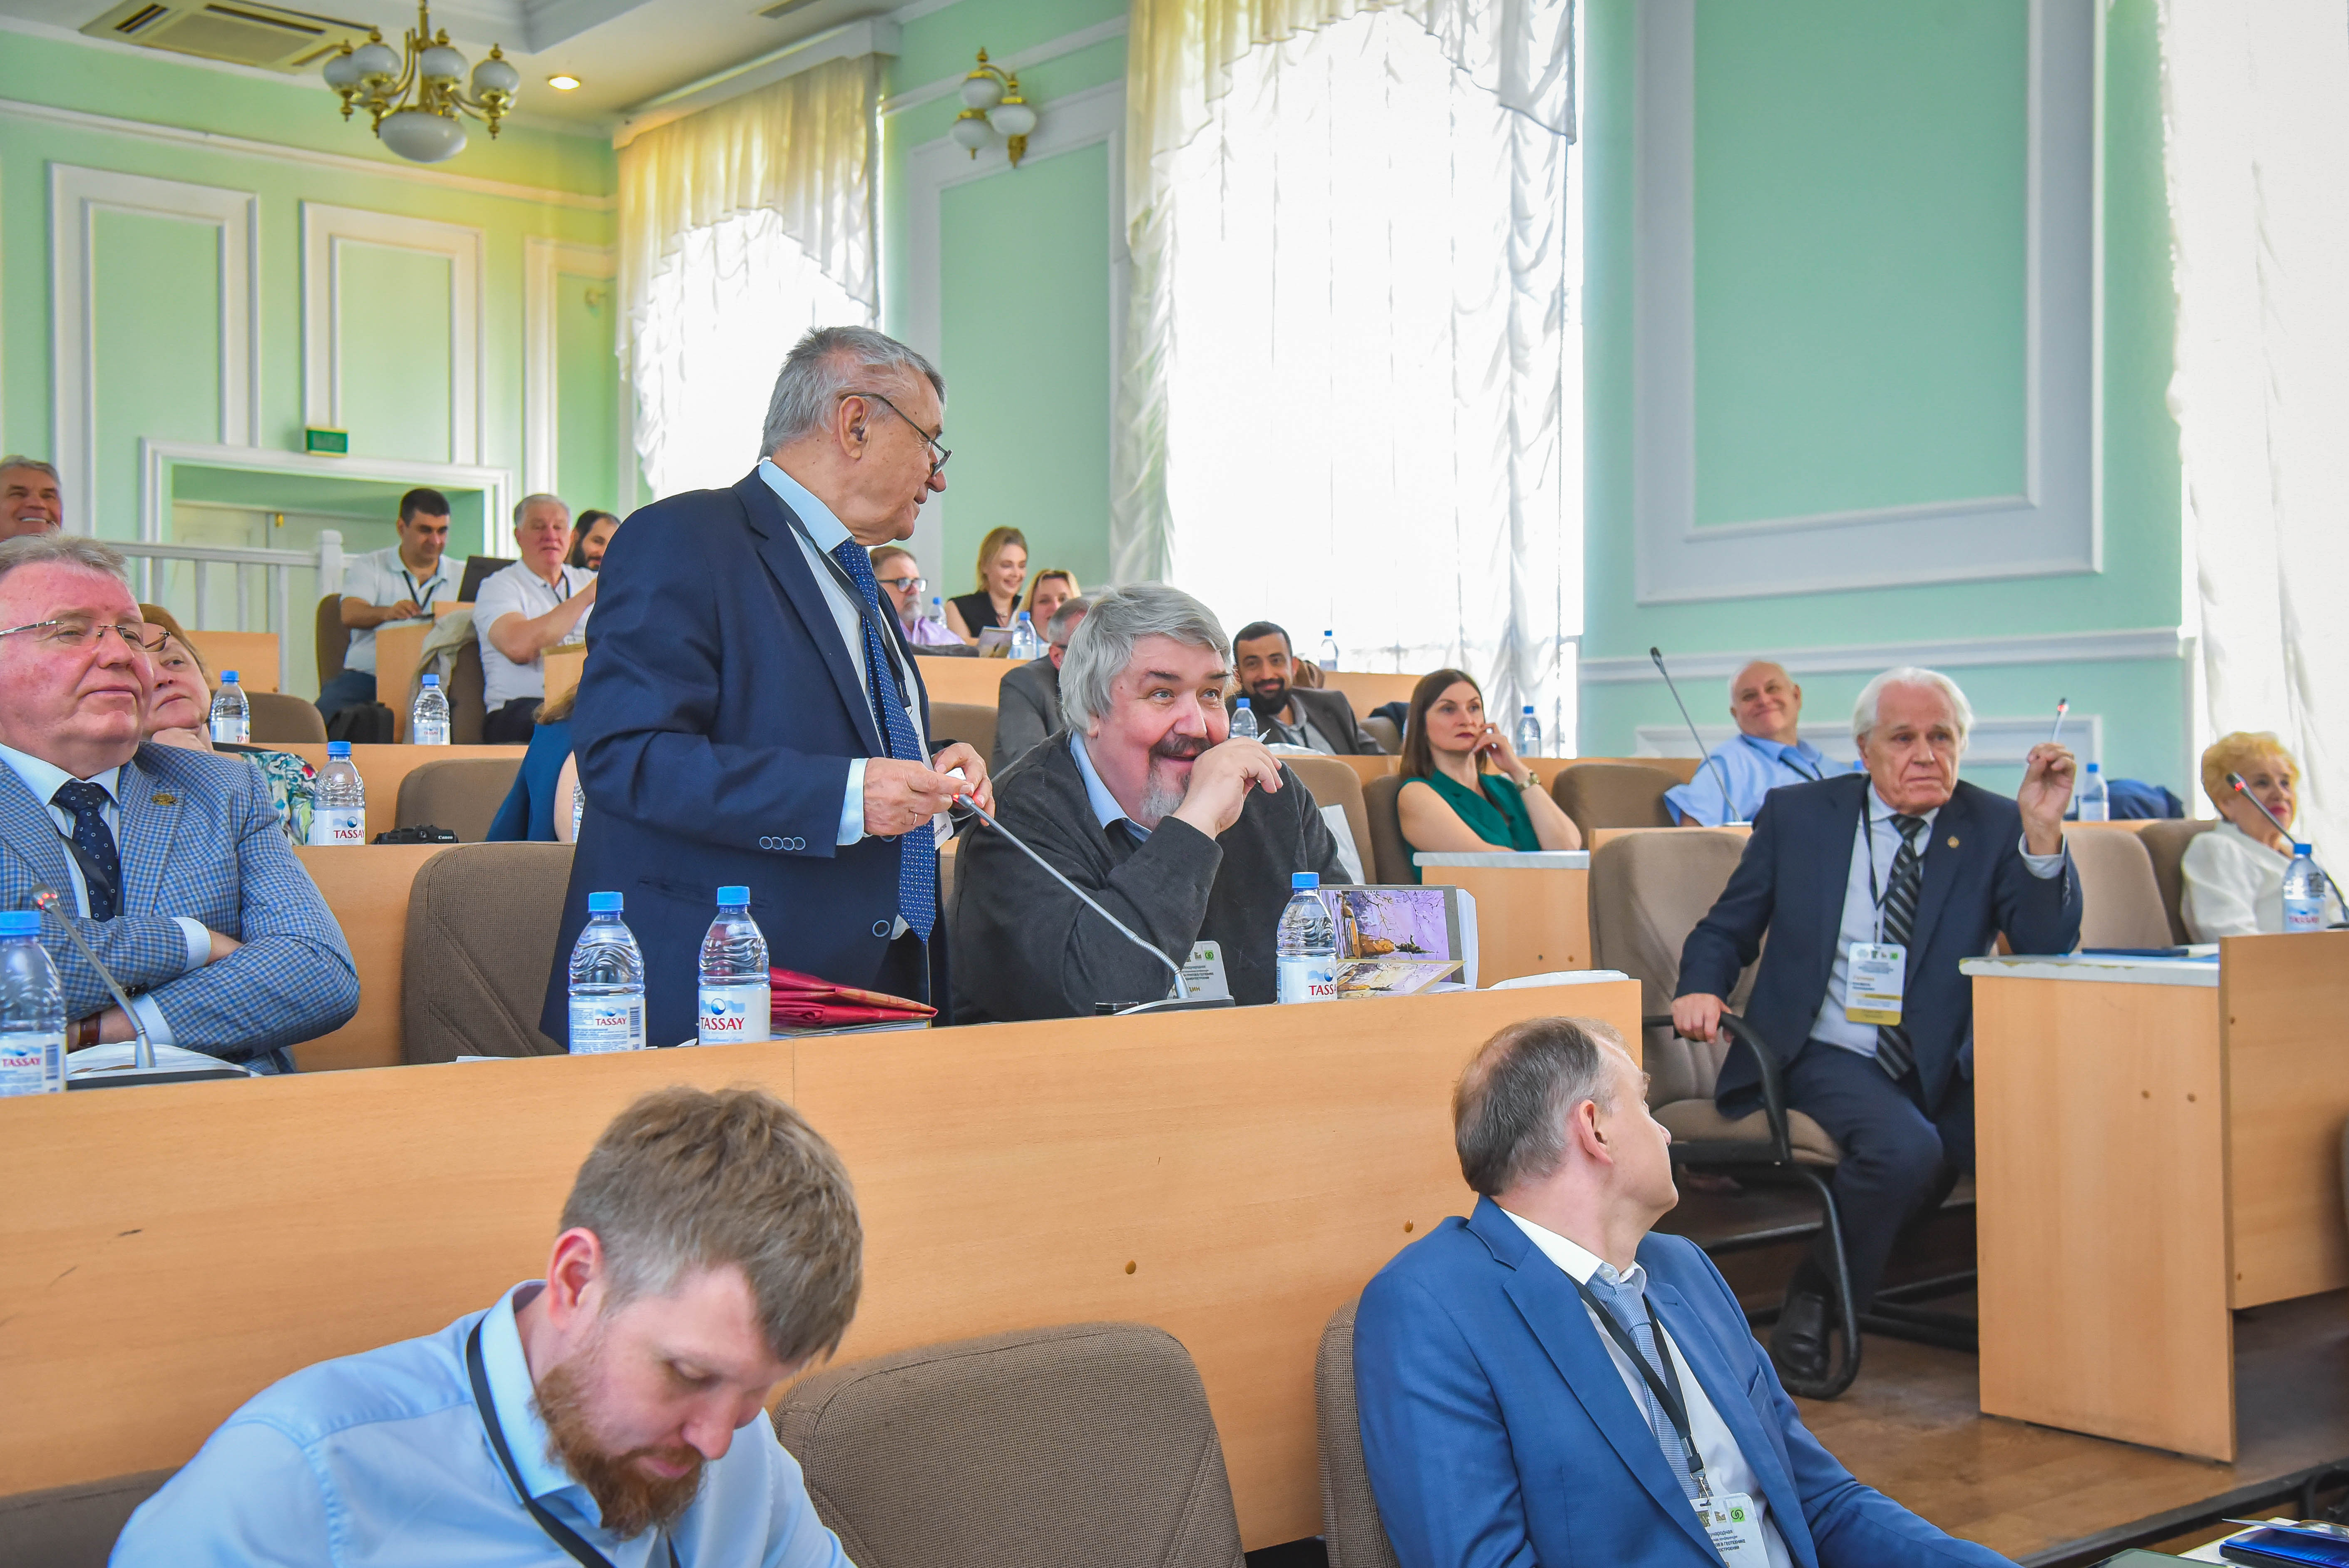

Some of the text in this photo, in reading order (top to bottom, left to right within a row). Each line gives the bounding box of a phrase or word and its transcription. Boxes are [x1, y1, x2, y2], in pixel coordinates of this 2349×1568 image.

[333, 829, 365, 839] TASSAY
[1308, 984, 1337, 995] TASSA
[595, 1017, 627, 1026] TASSAY
[700, 1017, 745, 1030] TASSAY
[3, 1057, 40, 1067] TASSAY
